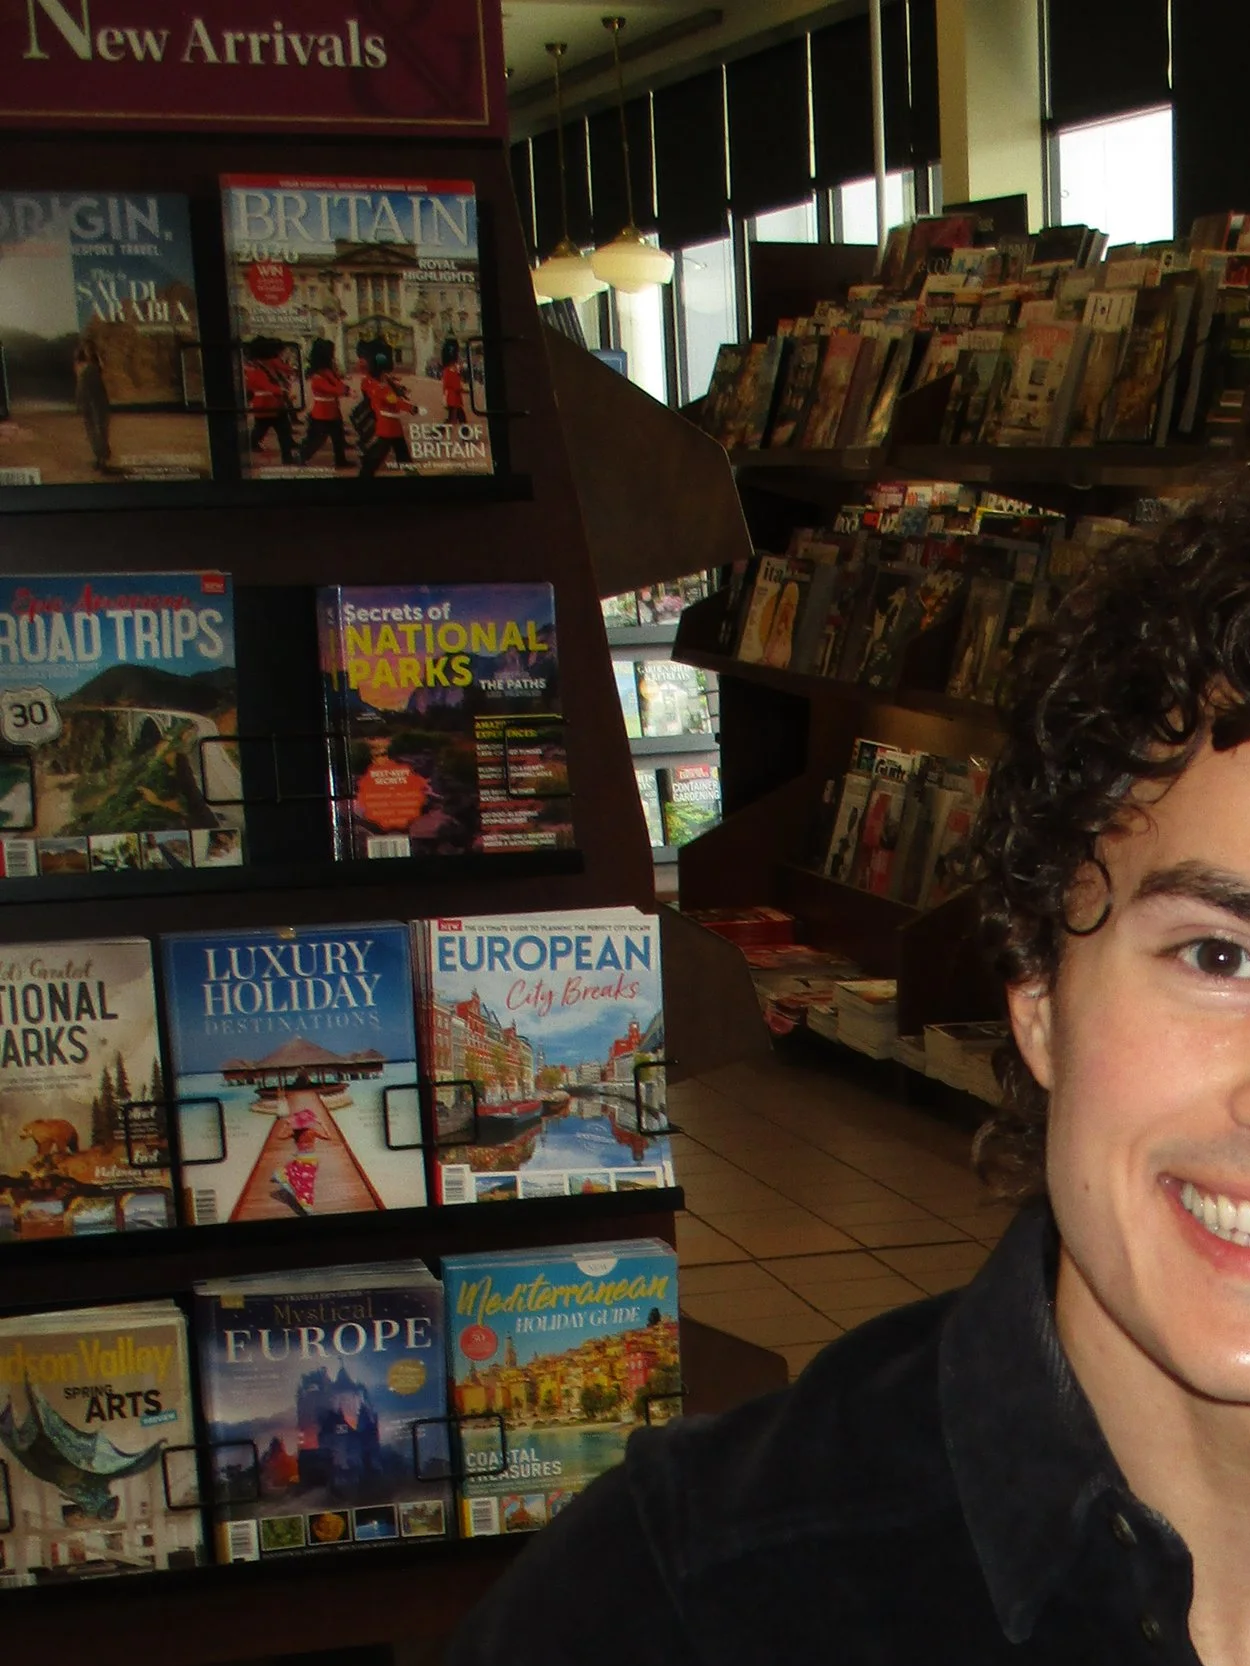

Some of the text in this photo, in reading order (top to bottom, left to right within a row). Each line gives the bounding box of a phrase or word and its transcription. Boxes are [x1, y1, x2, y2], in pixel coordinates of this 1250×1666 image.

[23, 0, 388, 69] New Arrivals
[231, 189, 476, 248] BRITAIN
[256, 264, 285, 278] WIN
[403, 270, 475, 283] HIGHLIGHTS
[418, 259, 457, 271] ROYAL
[409, 423, 483, 441] BEST OF
[411, 442, 487, 460] BRITAIN
[343, 602, 451, 622] Secrets of
[0, 608, 224, 664] ROAD TRIPS
[346, 620, 549, 658] NATIONAL
[347, 655, 475, 692] PARKS
[479, 678, 547, 691] THE PATHS
[12, 701, 48, 729] 30
[440, 922, 460, 931] NEW
[203, 940, 375, 982] LUXURY
[438, 935, 651, 972] EUROPEAN
[202, 973, 383, 1017] HOLIDAY
[506, 973, 640, 1018] City Breaks
[204, 1010, 384, 1037] DESTINATIONS
[273, 1296, 374, 1325] Mystical
[456, 1272, 669, 1327] Mediterranean
[515, 1306, 641, 1334] HOLIDAY GUIDE
[223, 1316, 432, 1364] EUROPE
[77, 1336, 173, 1385] Valley
[63, 1384, 113, 1400] SPRING
[85, 1389, 162, 1424] ARTS
